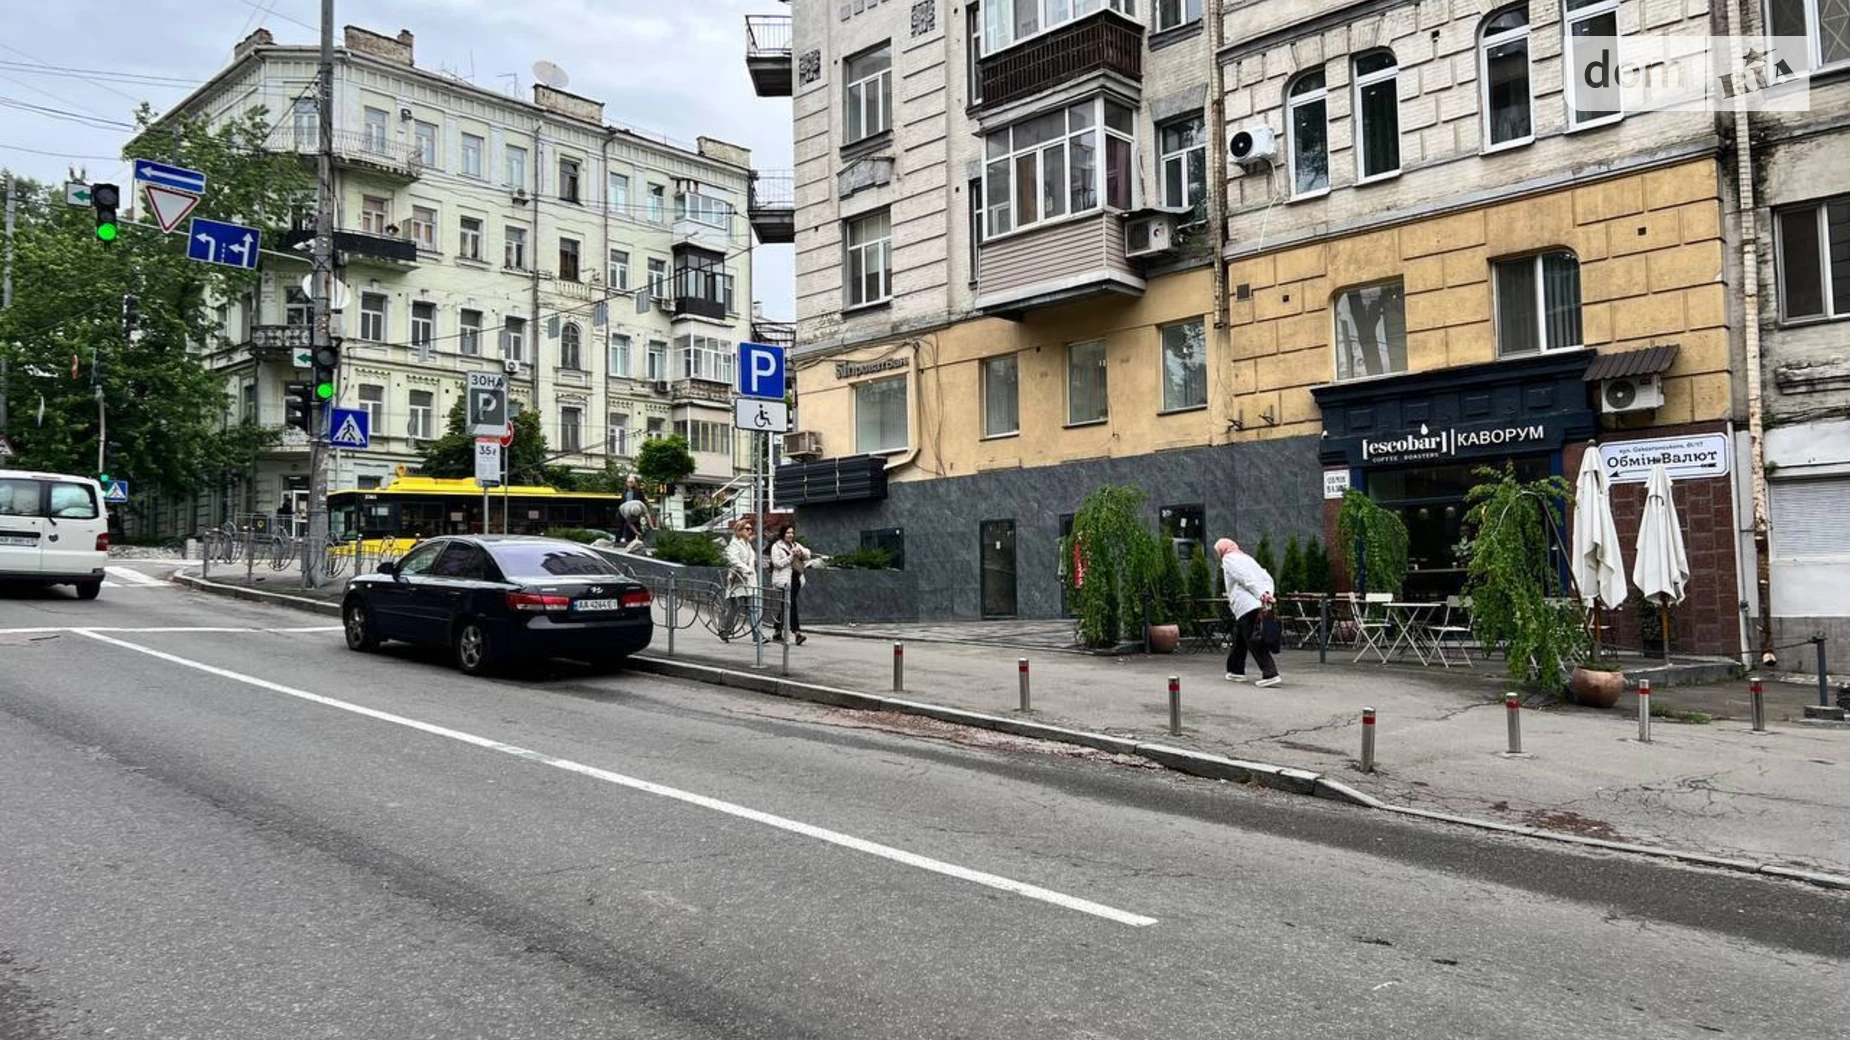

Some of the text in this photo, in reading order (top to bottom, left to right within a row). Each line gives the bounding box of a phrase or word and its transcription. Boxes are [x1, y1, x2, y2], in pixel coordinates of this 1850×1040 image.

[751, 349, 777, 392] P
[471, 374, 505, 388] ЗОНА
[1457, 425, 1544, 446] КАВОРУМ
[1372, 451, 1439, 463] COFFEE ROASTERS
[1607, 450, 1717, 468] Обмін Валют
